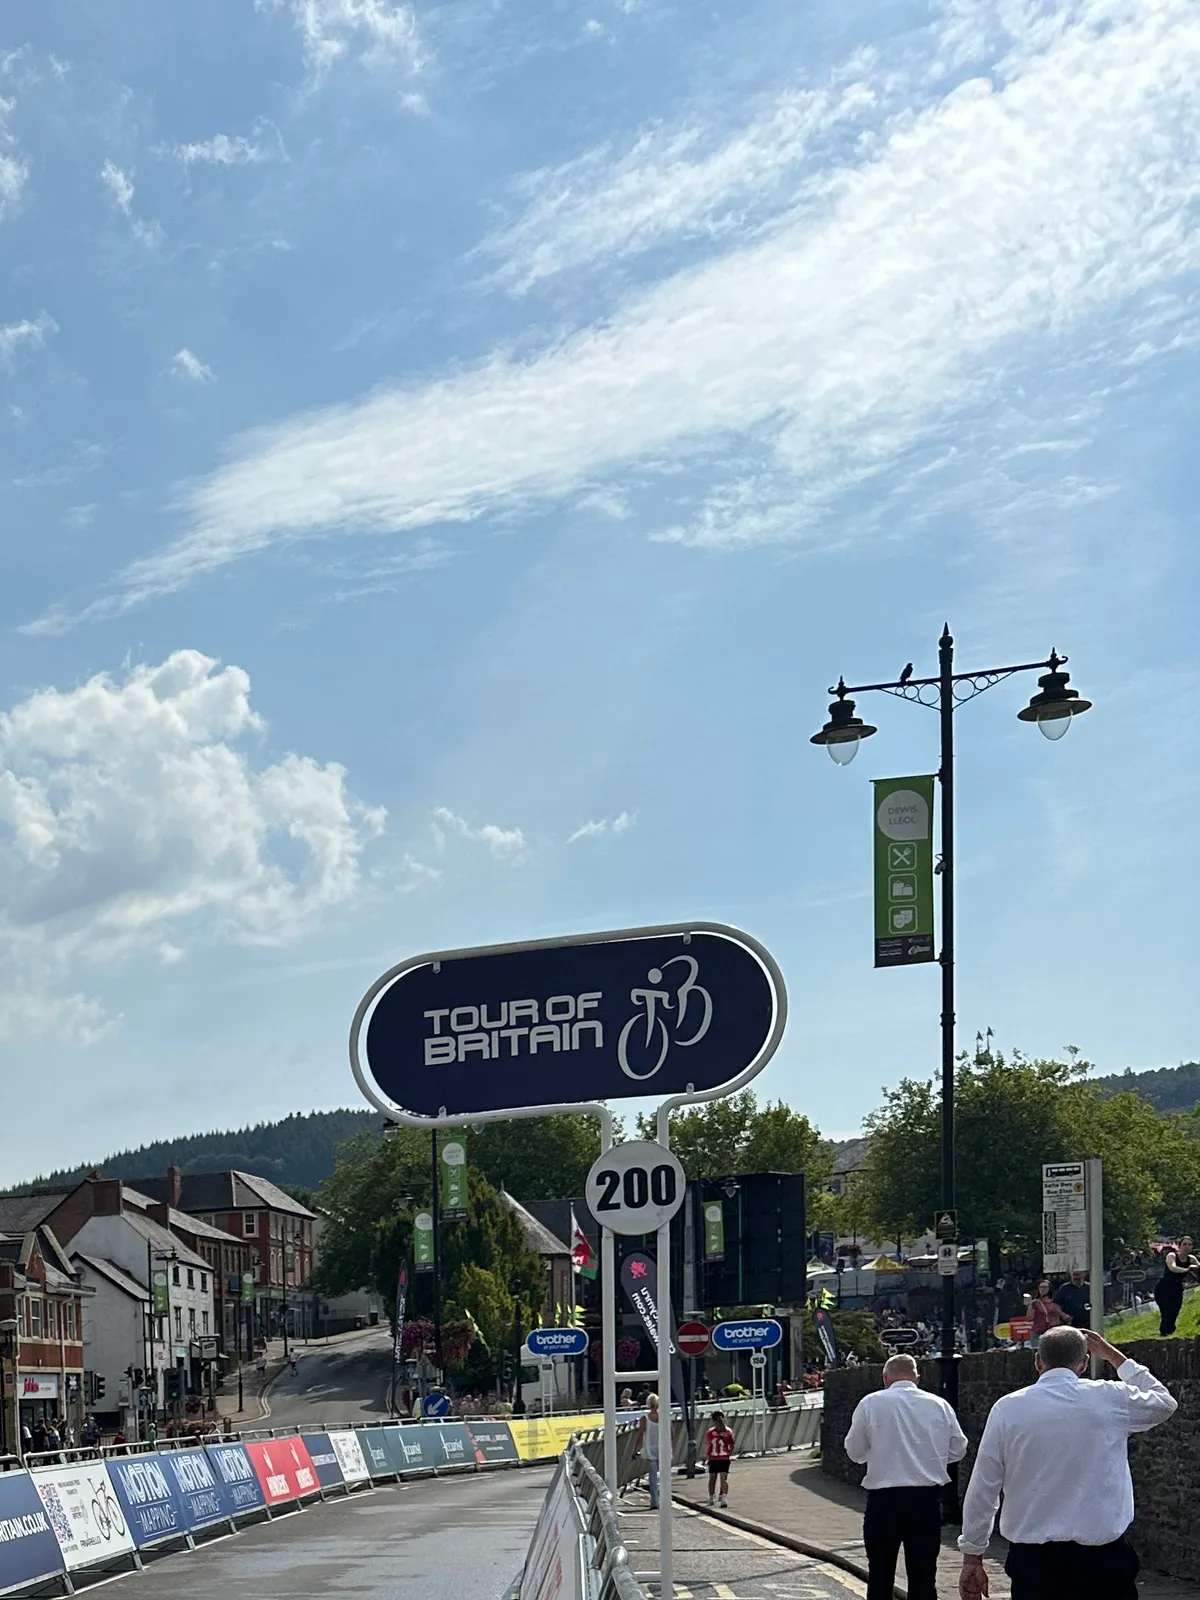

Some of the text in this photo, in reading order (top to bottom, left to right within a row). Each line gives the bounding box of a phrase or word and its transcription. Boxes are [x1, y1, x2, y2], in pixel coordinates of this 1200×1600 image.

[887, 804, 918, 816] DEWIS
[888, 815, 917, 826] LLEOL
[423, 991, 603, 1035] TOUR OF
[424, 1020, 604, 1066] BRITAIN
[595, 1164, 677, 1212] 200
[536, 1334, 578, 1345] brother
[724, 1327, 770, 1339] brother
[752, 1357, 765, 1365] 150
[169, 1453, 216, 1493] MOTION
[213, 1447, 254, 1484] MOTION
[117, 1460, 172, 1506] MOTION
[231, 1483, 258, 1506] MAPPING
[190, 1491, 220, 1518] MAPPING
[138, 1504, 176, 1534] MAPPING
